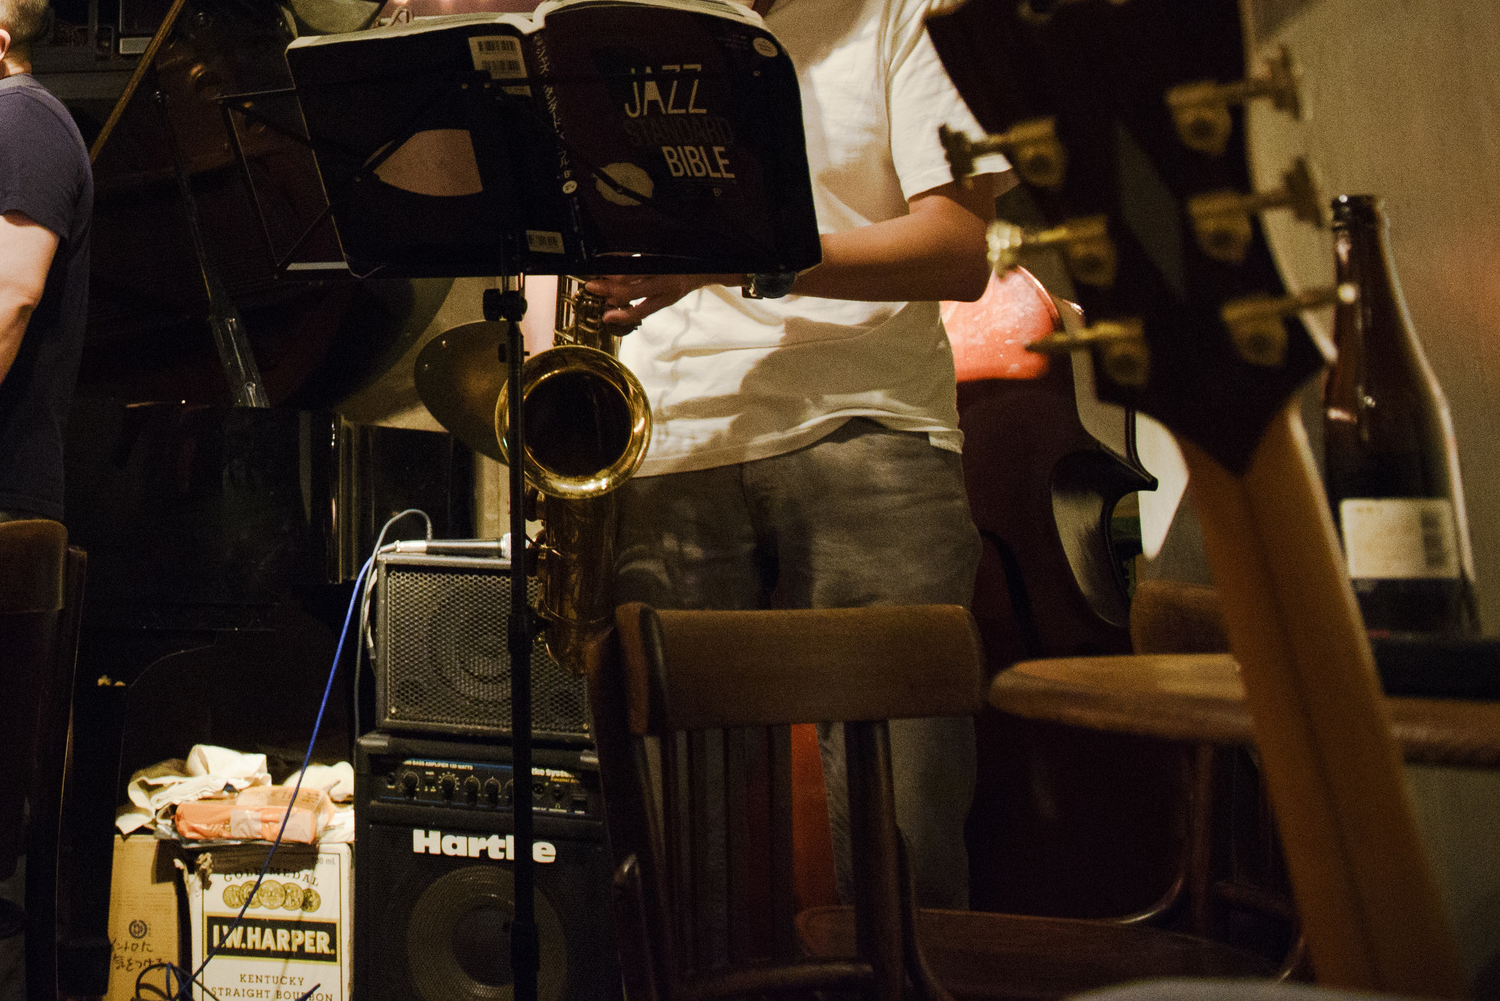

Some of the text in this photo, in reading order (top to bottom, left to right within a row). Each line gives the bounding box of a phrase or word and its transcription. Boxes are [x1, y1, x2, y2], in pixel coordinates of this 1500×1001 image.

[624, 64, 707, 117] JAZZ
[661, 145, 735, 178] BIBLE
[269, 866, 319, 886] MEDAL
[239, 974, 305, 986] KENTUCKY
[211, 987, 271, 999] STRAIGHT
